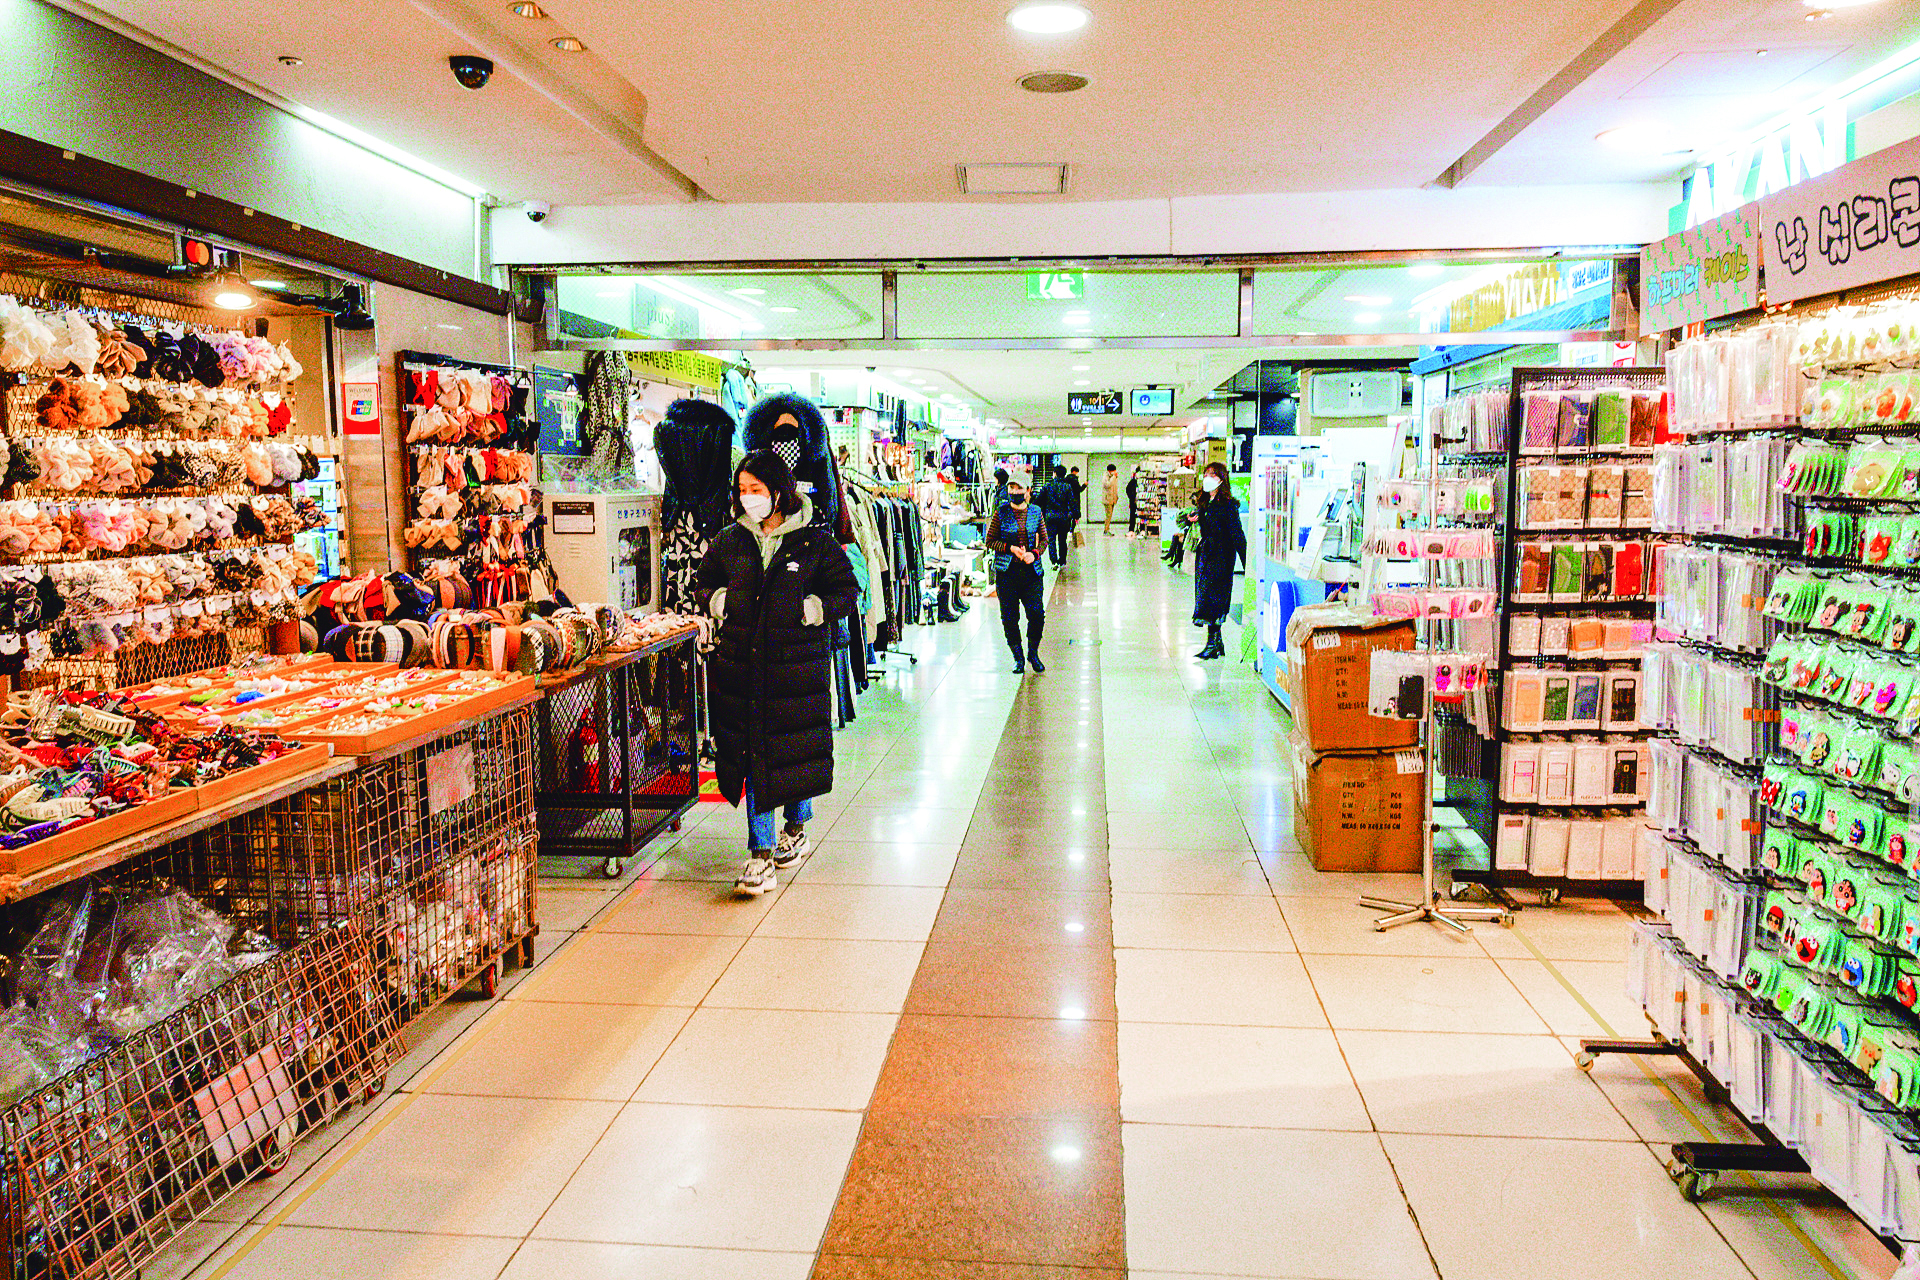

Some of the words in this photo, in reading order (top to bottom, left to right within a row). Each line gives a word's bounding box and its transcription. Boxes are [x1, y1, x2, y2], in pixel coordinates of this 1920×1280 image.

[1647, 264, 1700, 308] 하프미러
[1704, 243, 1749, 289] 케이스
[1775, 216, 1808, 275] 난
